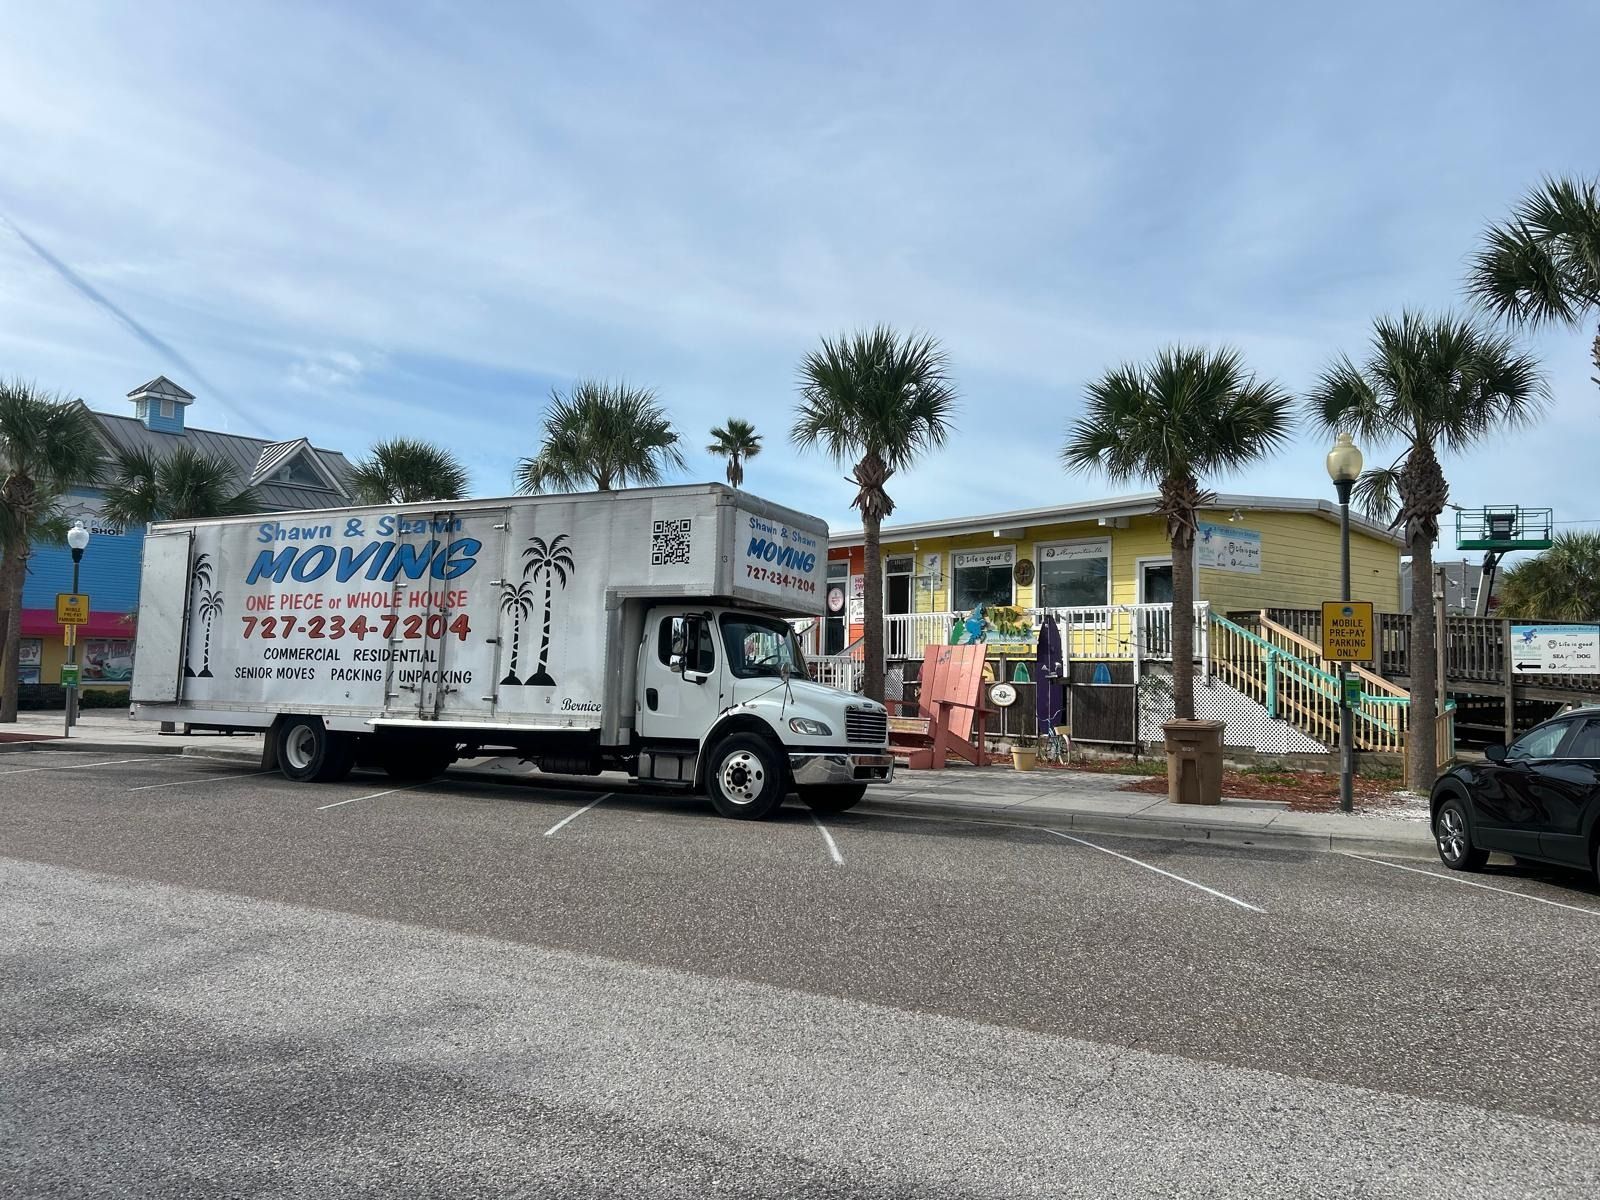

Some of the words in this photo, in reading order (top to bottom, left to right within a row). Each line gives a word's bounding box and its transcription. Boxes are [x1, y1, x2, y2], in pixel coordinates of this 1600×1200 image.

[257, 522, 331, 543] Shawn
[344, 518, 365, 537] &
[376, 515, 462, 536] Shawn
[749, 517, 777, 534] Shawn
[780, 527, 788, 538] &
[792, 531, 816, 547] Shawn
[246, 538, 482, 585] MOVING
[747, 537, 816, 573] MOVING
[966, 555, 978, 563] Life
[747, 564, 815, 594] 727-234-7204
[246, 595, 275, 611] ONE
[280, 593, 324, 610] PIECE
[328, 598, 341, 609] or
[347, 591, 402, 608] WHOLE
[409, 590, 467, 609] HOUSE
[242, 614, 471, 641] 727-234-7204
[1332, 619, 1364, 627] MOBILE
[1329, 629, 1366, 637] PRE-PAY
[1329, 639, 1366, 647] PARKING
[264, 648, 340, 661] COMMERCIAL
[353, 649, 437, 662] RESIDENTIAL
[1336, 649, 1359, 657] ONLY
[234, 667, 272, 679] SENIOR
[276, 667, 315, 679] MOVES
[331, 668, 382, 681] PACKING
[399, 670, 472, 683] UNPACKING
[561, 697, 602, 712] Bernice
